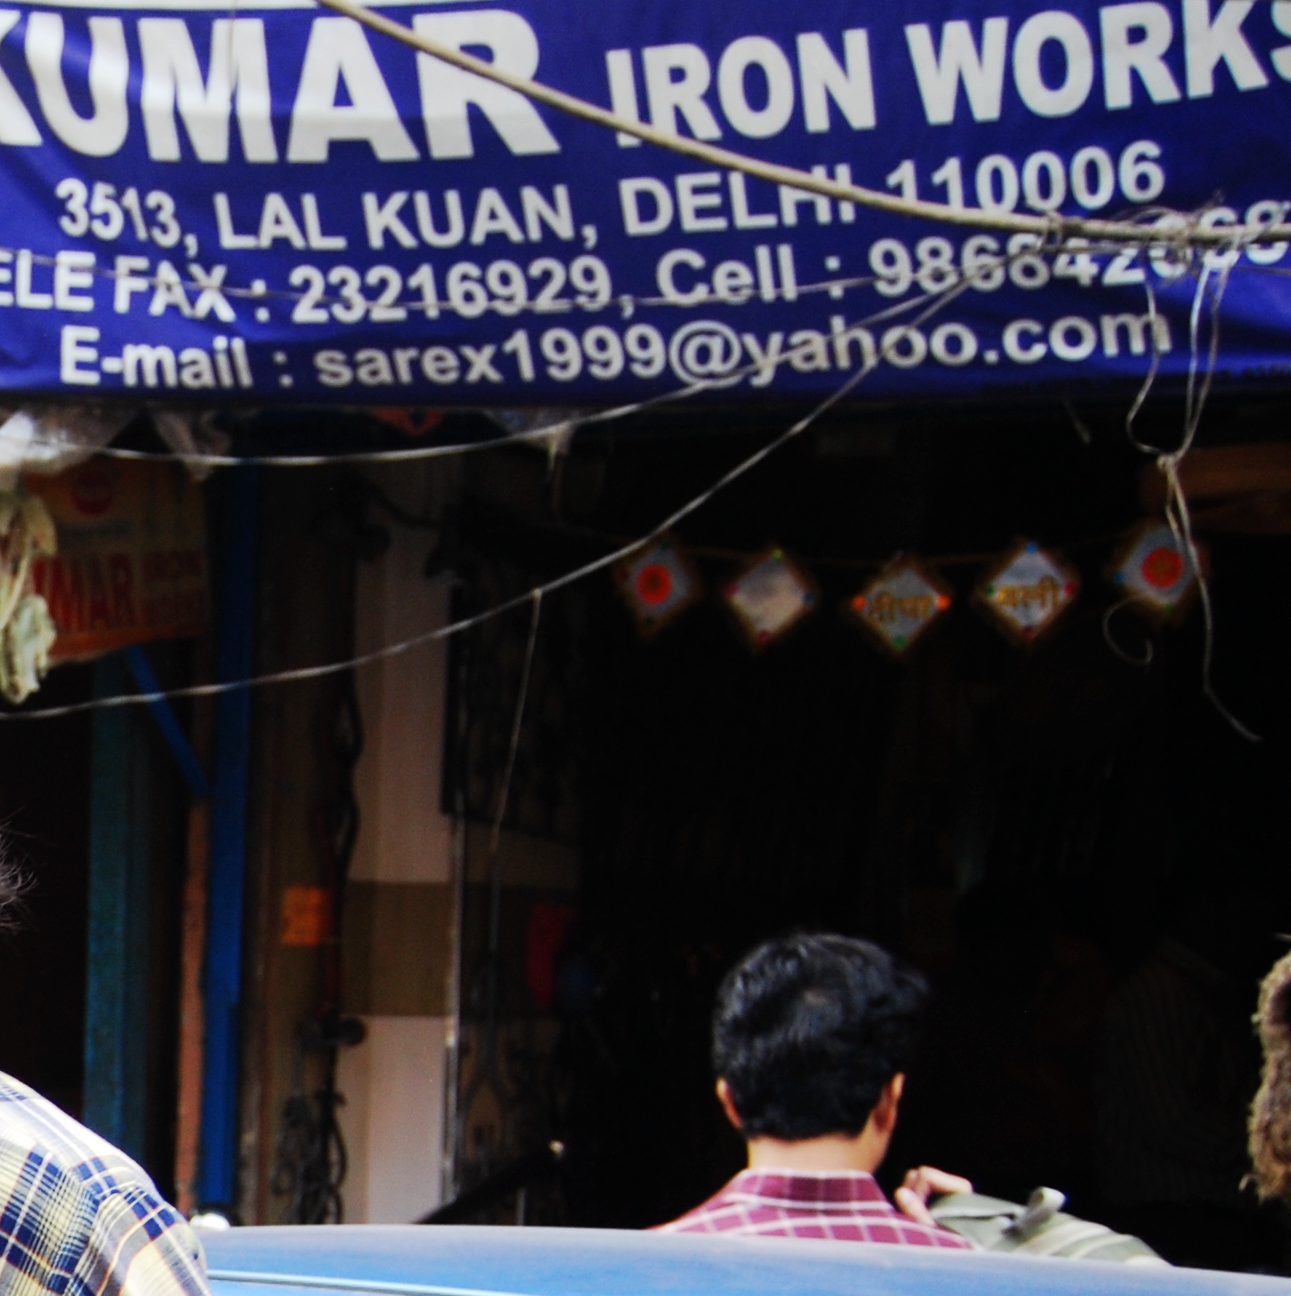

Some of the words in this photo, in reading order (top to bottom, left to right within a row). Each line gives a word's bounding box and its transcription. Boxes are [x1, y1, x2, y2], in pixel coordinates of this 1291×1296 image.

[605, 28, 876, 148] IRON
[55, 178, 199, 258] 3513,
[215, 192, 347, 249] LAL
[362, 184, 598, 249] KUAN,
[886, 140, 1165, 216] 110006
[114, 256, 236, 323] FAX
[289, 255, 635, 325] 23216929,
[655, 244, 798, 308] Cell
[60, 325, 253, 388] E-mail
[313, 312, 1172, 387] sarex1999@yahoo.com
[33, 550, 134, 631] MAR
